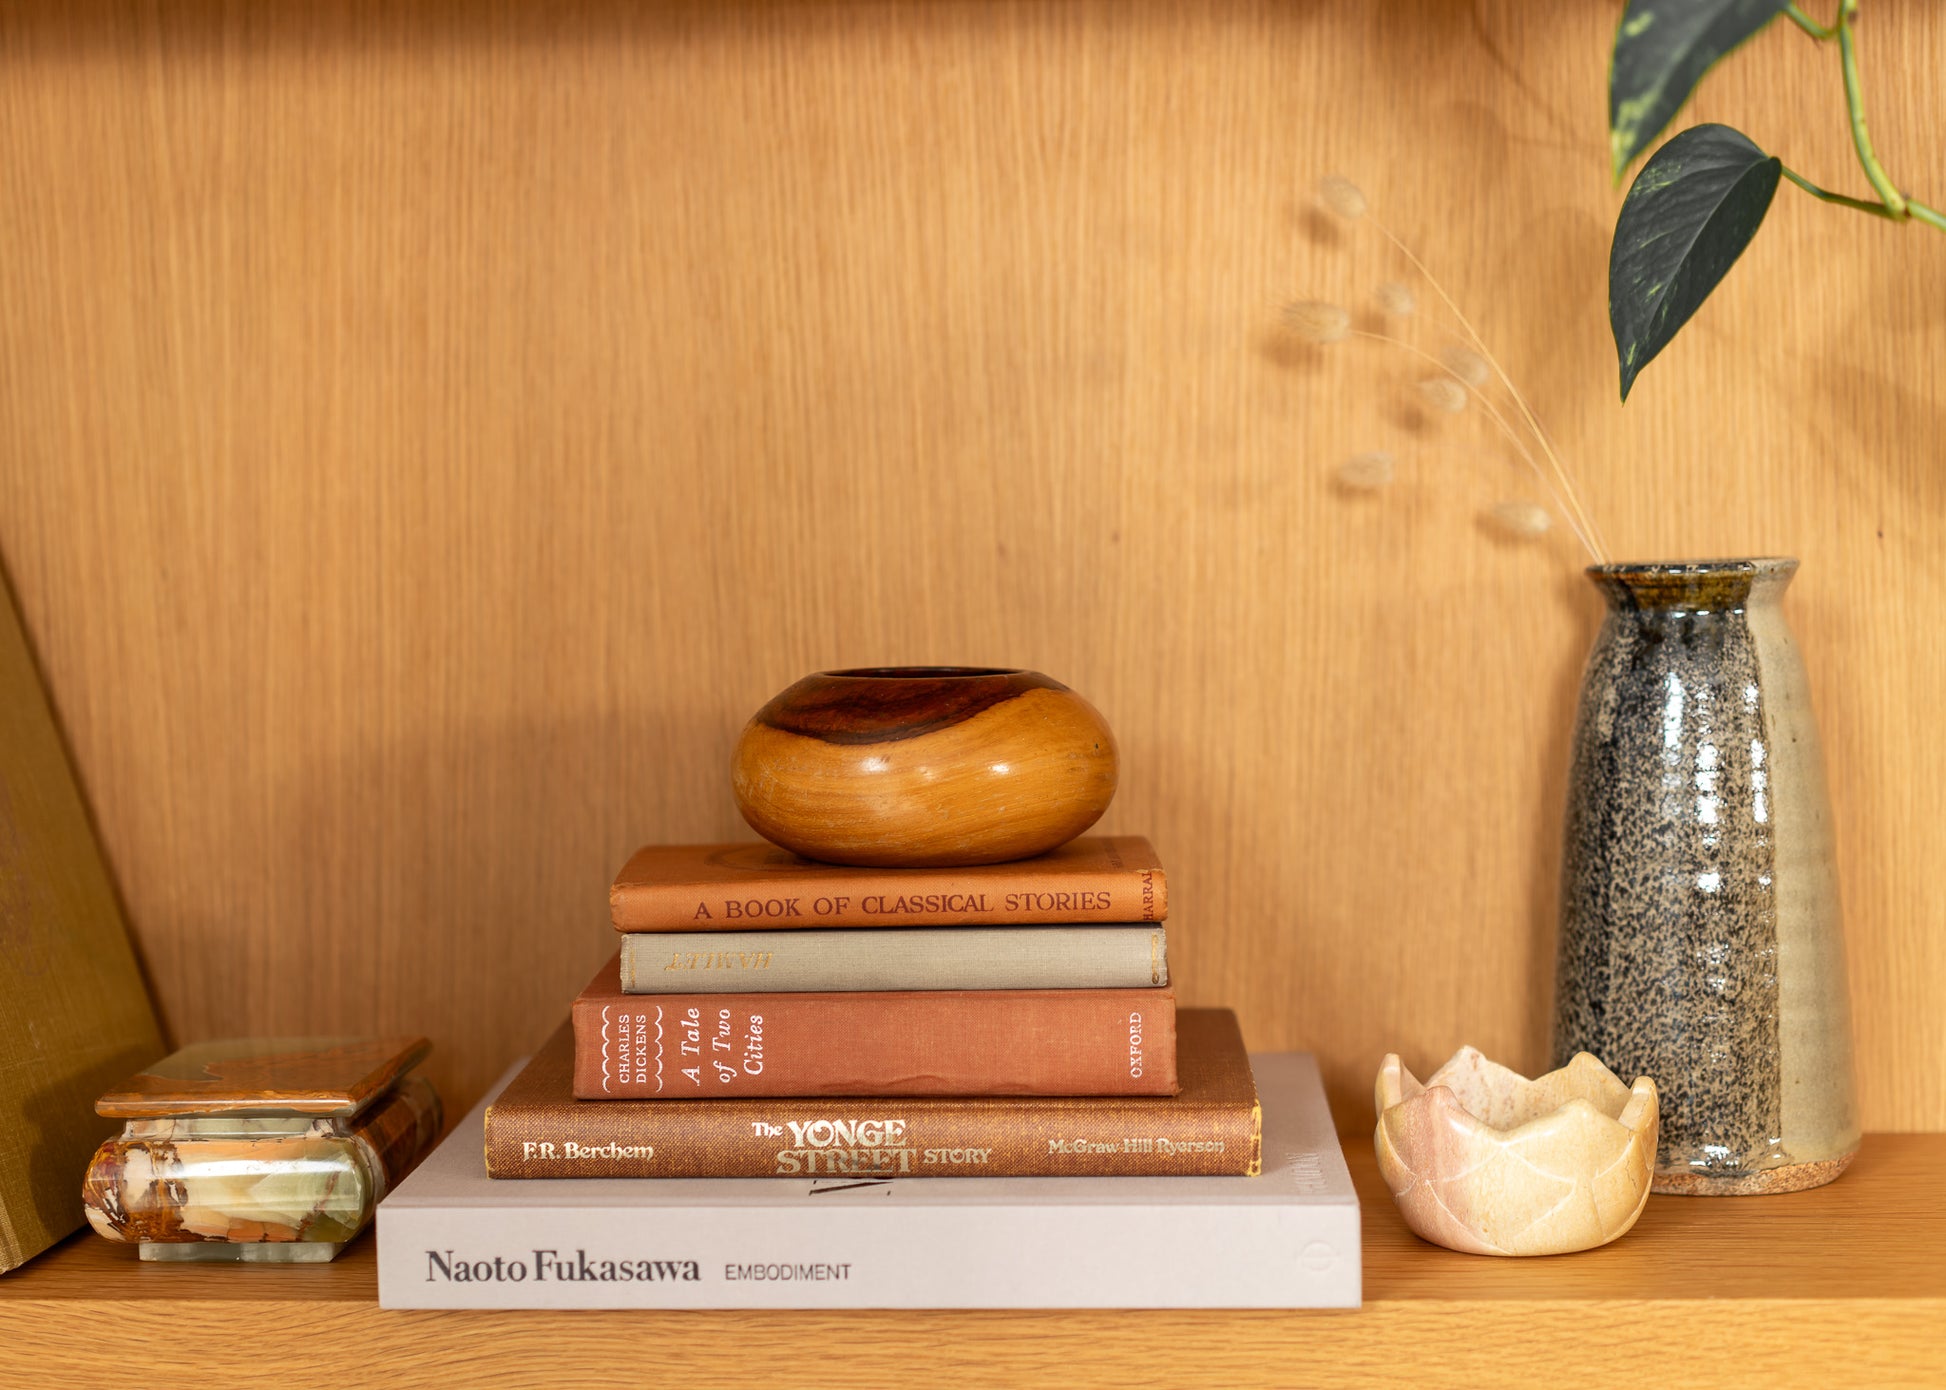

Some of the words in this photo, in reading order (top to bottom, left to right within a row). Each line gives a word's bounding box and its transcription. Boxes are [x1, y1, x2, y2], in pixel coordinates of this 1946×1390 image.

[693, 901, 713, 920] A
[724, 897, 803, 919] BOOK
[813, 896, 850, 916] OF
[861, 894, 994, 915] CLASSICAL
[1004, 891, 1112, 912] STORIES
[664, 951, 774, 972] HAMLET
[680, 1007, 700, 1056] Tale
[712, 1008, 731, 1052] Two
[618, 1013, 630, 1084] CHARLES
[635, 1014, 647, 1084] DICKENS
[743, 1015, 764, 1075] Cities
[1129, 1012, 1143, 1078] OXFORD
[680, 1065, 700, 1087] A
[712, 1060, 737, 1083] of
[751, 1121, 784, 1139] The
[786, 1119, 907, 1148] YONGE
[1155, 1138, 1226, 1157] Ryerson
[564, 1141, 654, 1161] Berchem
[776, 1147, 918, 1174] STREET
[923, 1147, 992, 1164] STORY
[425, 1249, 527, 1283] Naoto
[532, 1248, 701, 1283] Fukasawa
[724, 1263, 851, 1281] EMBODIMENT
